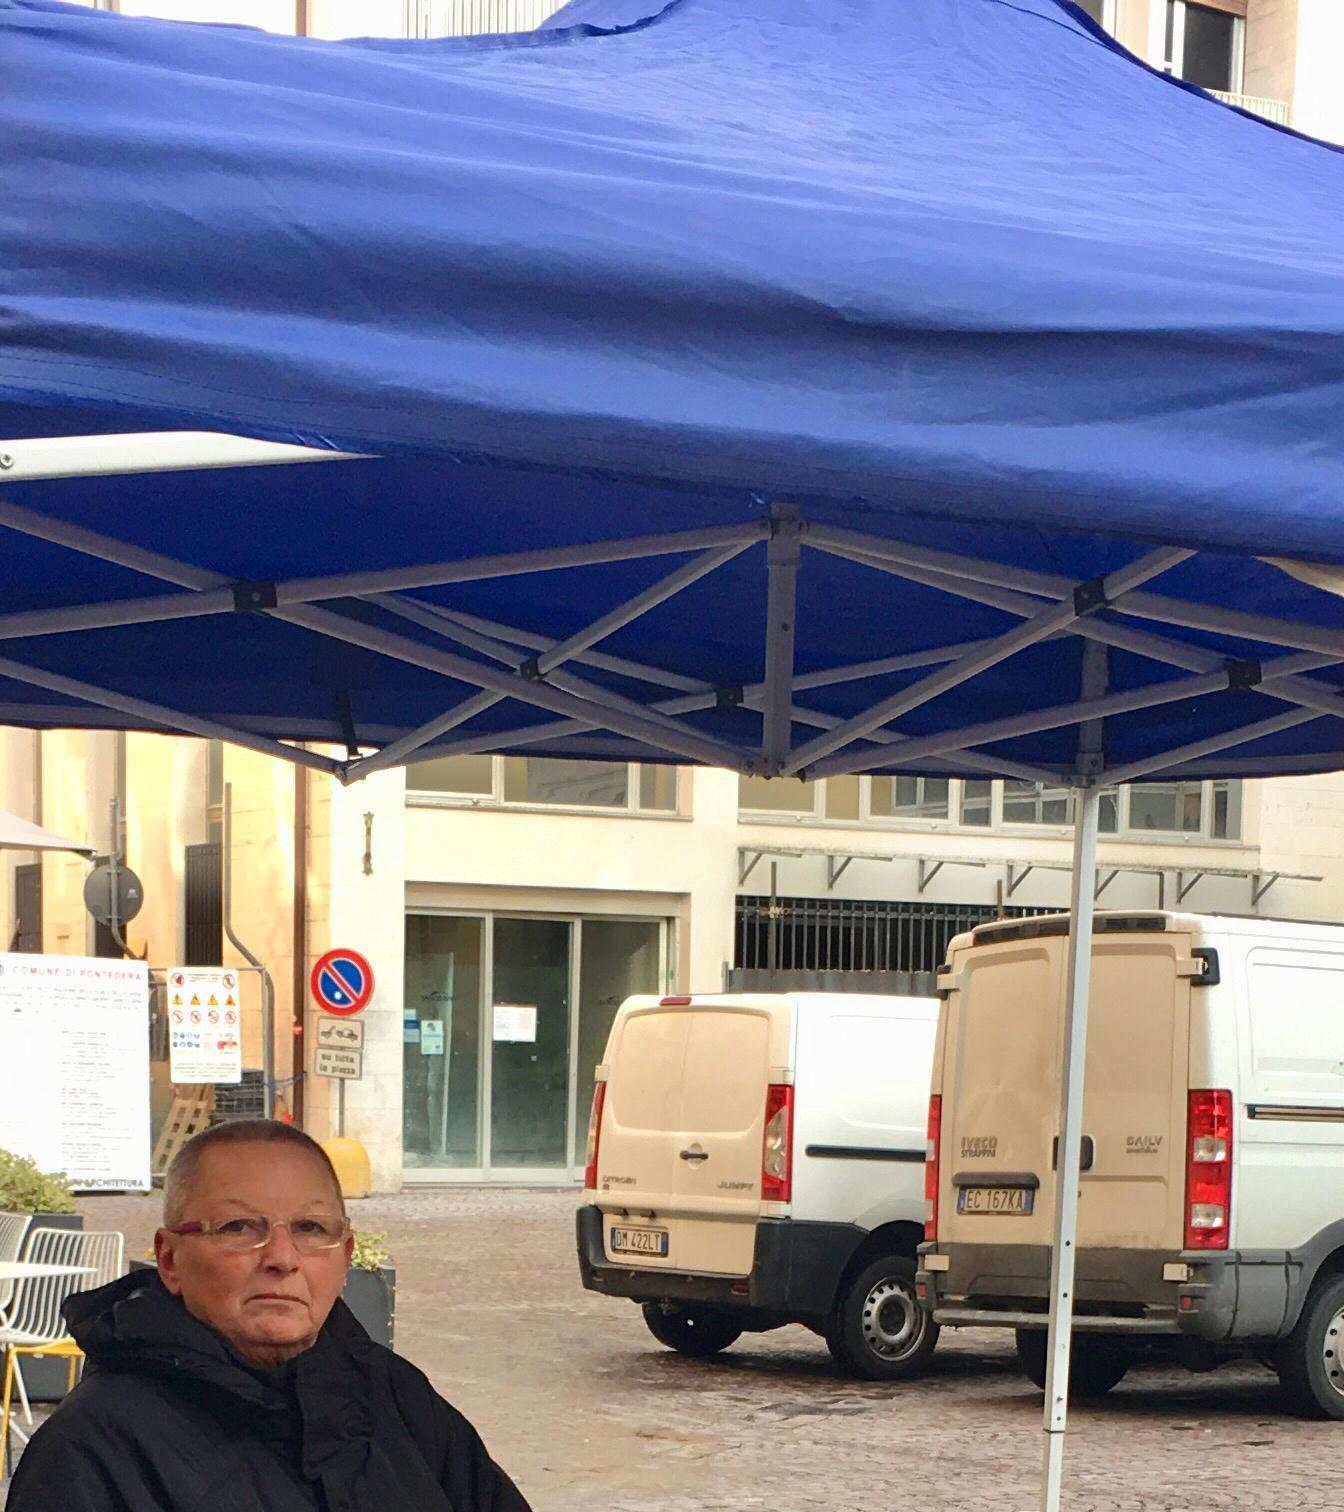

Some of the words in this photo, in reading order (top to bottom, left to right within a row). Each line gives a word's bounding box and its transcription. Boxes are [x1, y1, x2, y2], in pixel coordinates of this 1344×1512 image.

[12, 966, 60, 976] COMUNE
[960, 1136, 998, 1149] IVECO
[966, 1189, 982, 1209] EC
[986, 1189, 1024, 1209] 167KA
